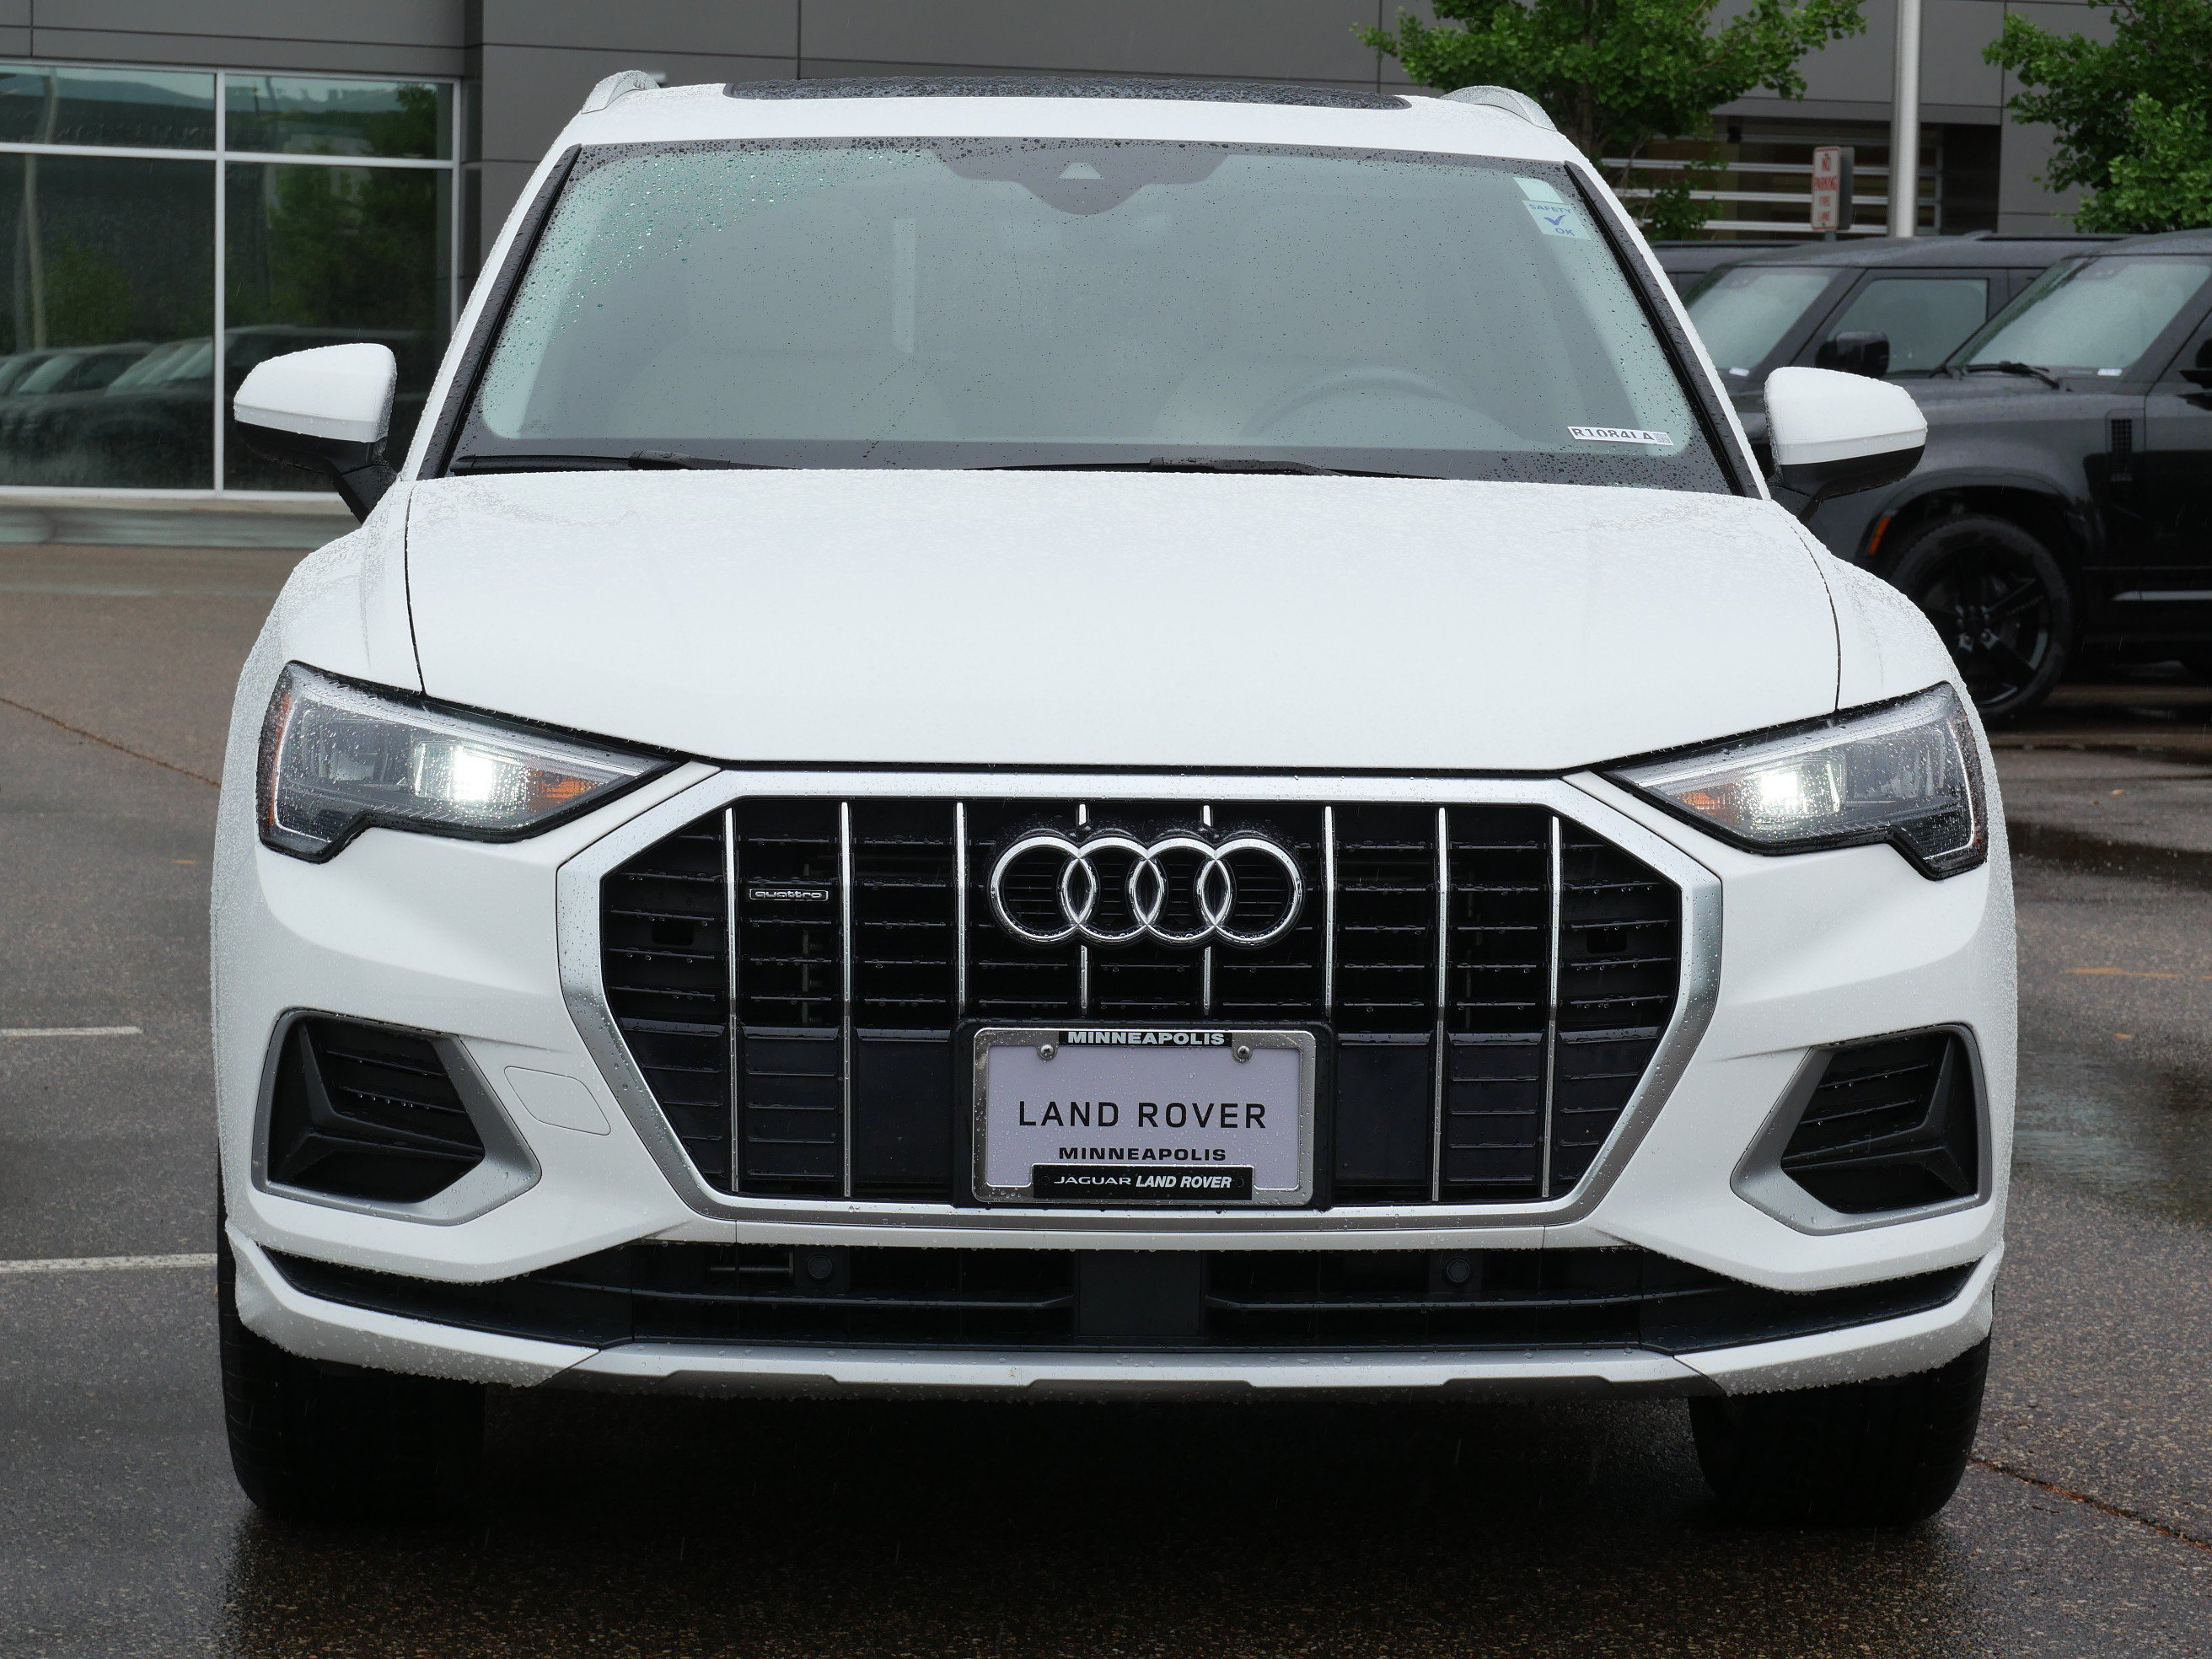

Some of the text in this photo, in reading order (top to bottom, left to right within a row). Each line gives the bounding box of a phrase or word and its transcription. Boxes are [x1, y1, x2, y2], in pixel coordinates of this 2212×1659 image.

[1529, 204, 1571, 213] SAFETY
[754, 890, 822, 899] quattro
[1068, 1031, 1225, 1045] MINNEAPOLIS
[1018, 1101, 1266, 1128] LAND ROVER
[1059, 1147, 1227, 1161] MINNEAPOLIS
[1054, 1175, 1232, 1189] JAGUAR LAND ROVER
